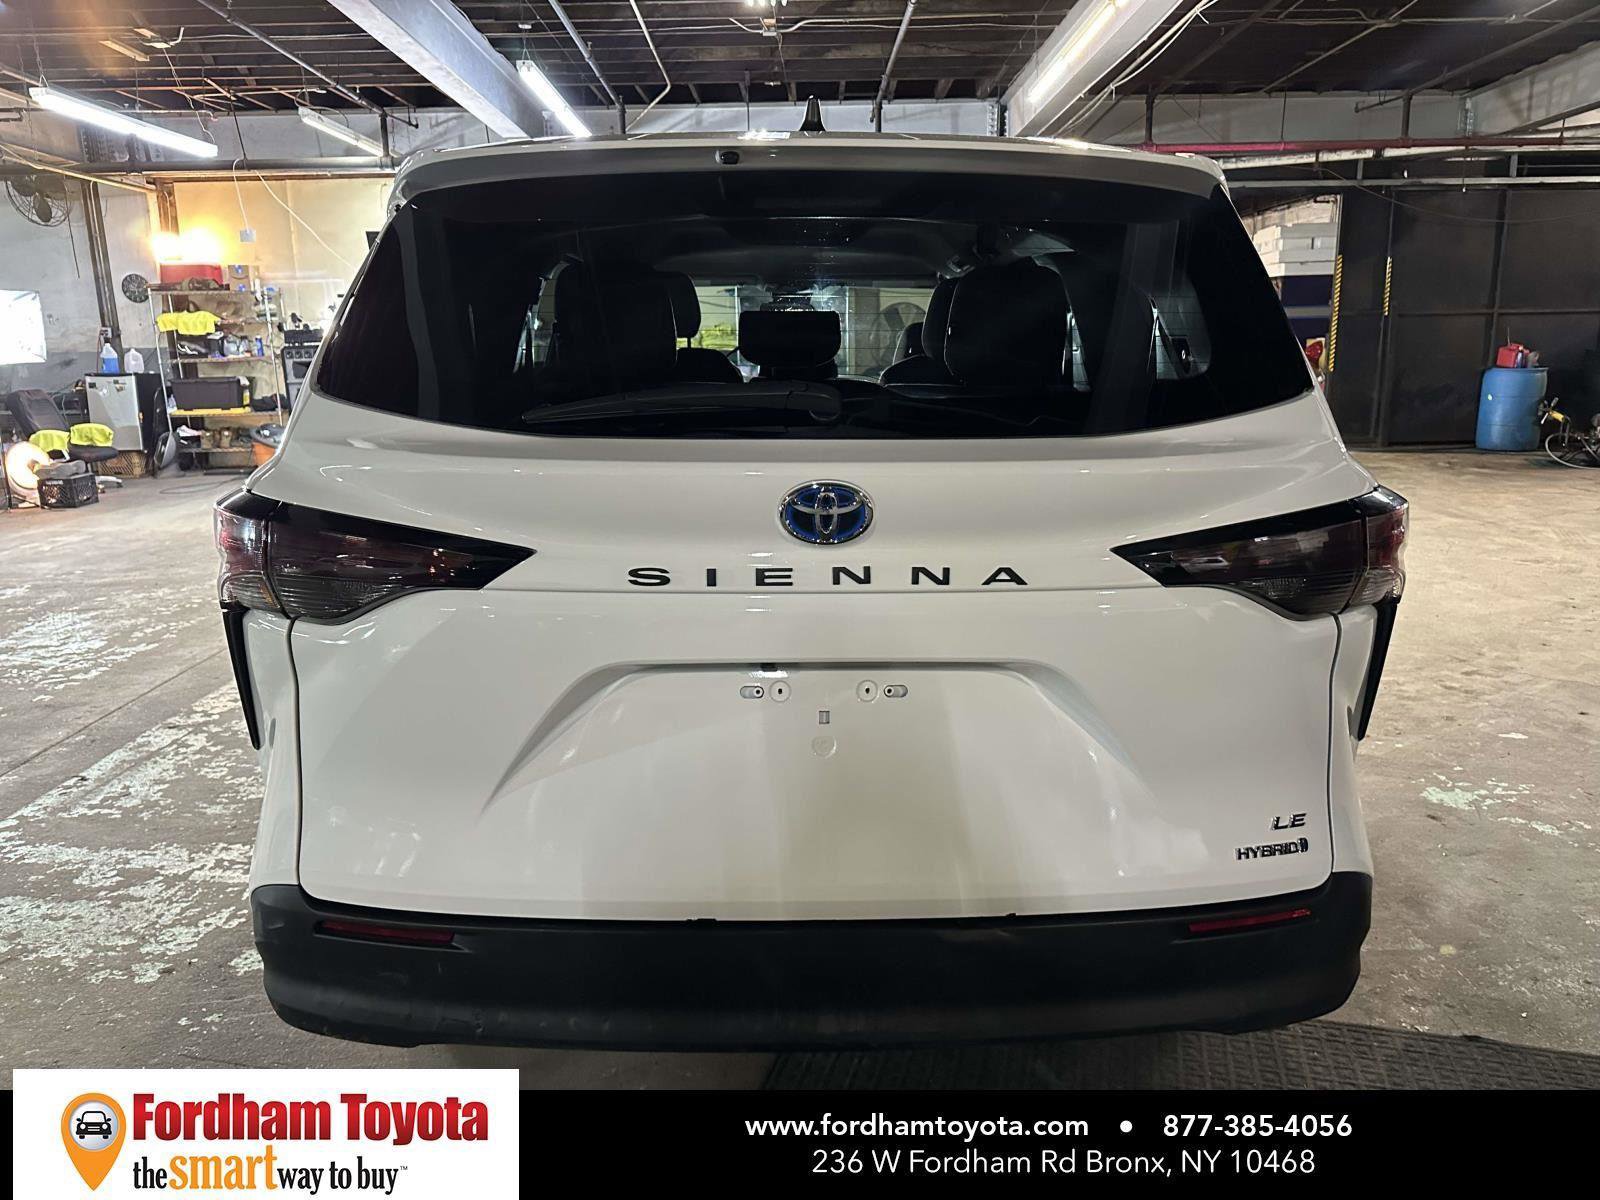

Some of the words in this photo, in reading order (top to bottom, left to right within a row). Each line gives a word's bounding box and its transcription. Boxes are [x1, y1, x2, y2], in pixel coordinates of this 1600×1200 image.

[627, 565, 1030, 588] SIENNA
[1271, 812, 1307, 831] LE
[1235, 842, 1299, 861] HYBRID
